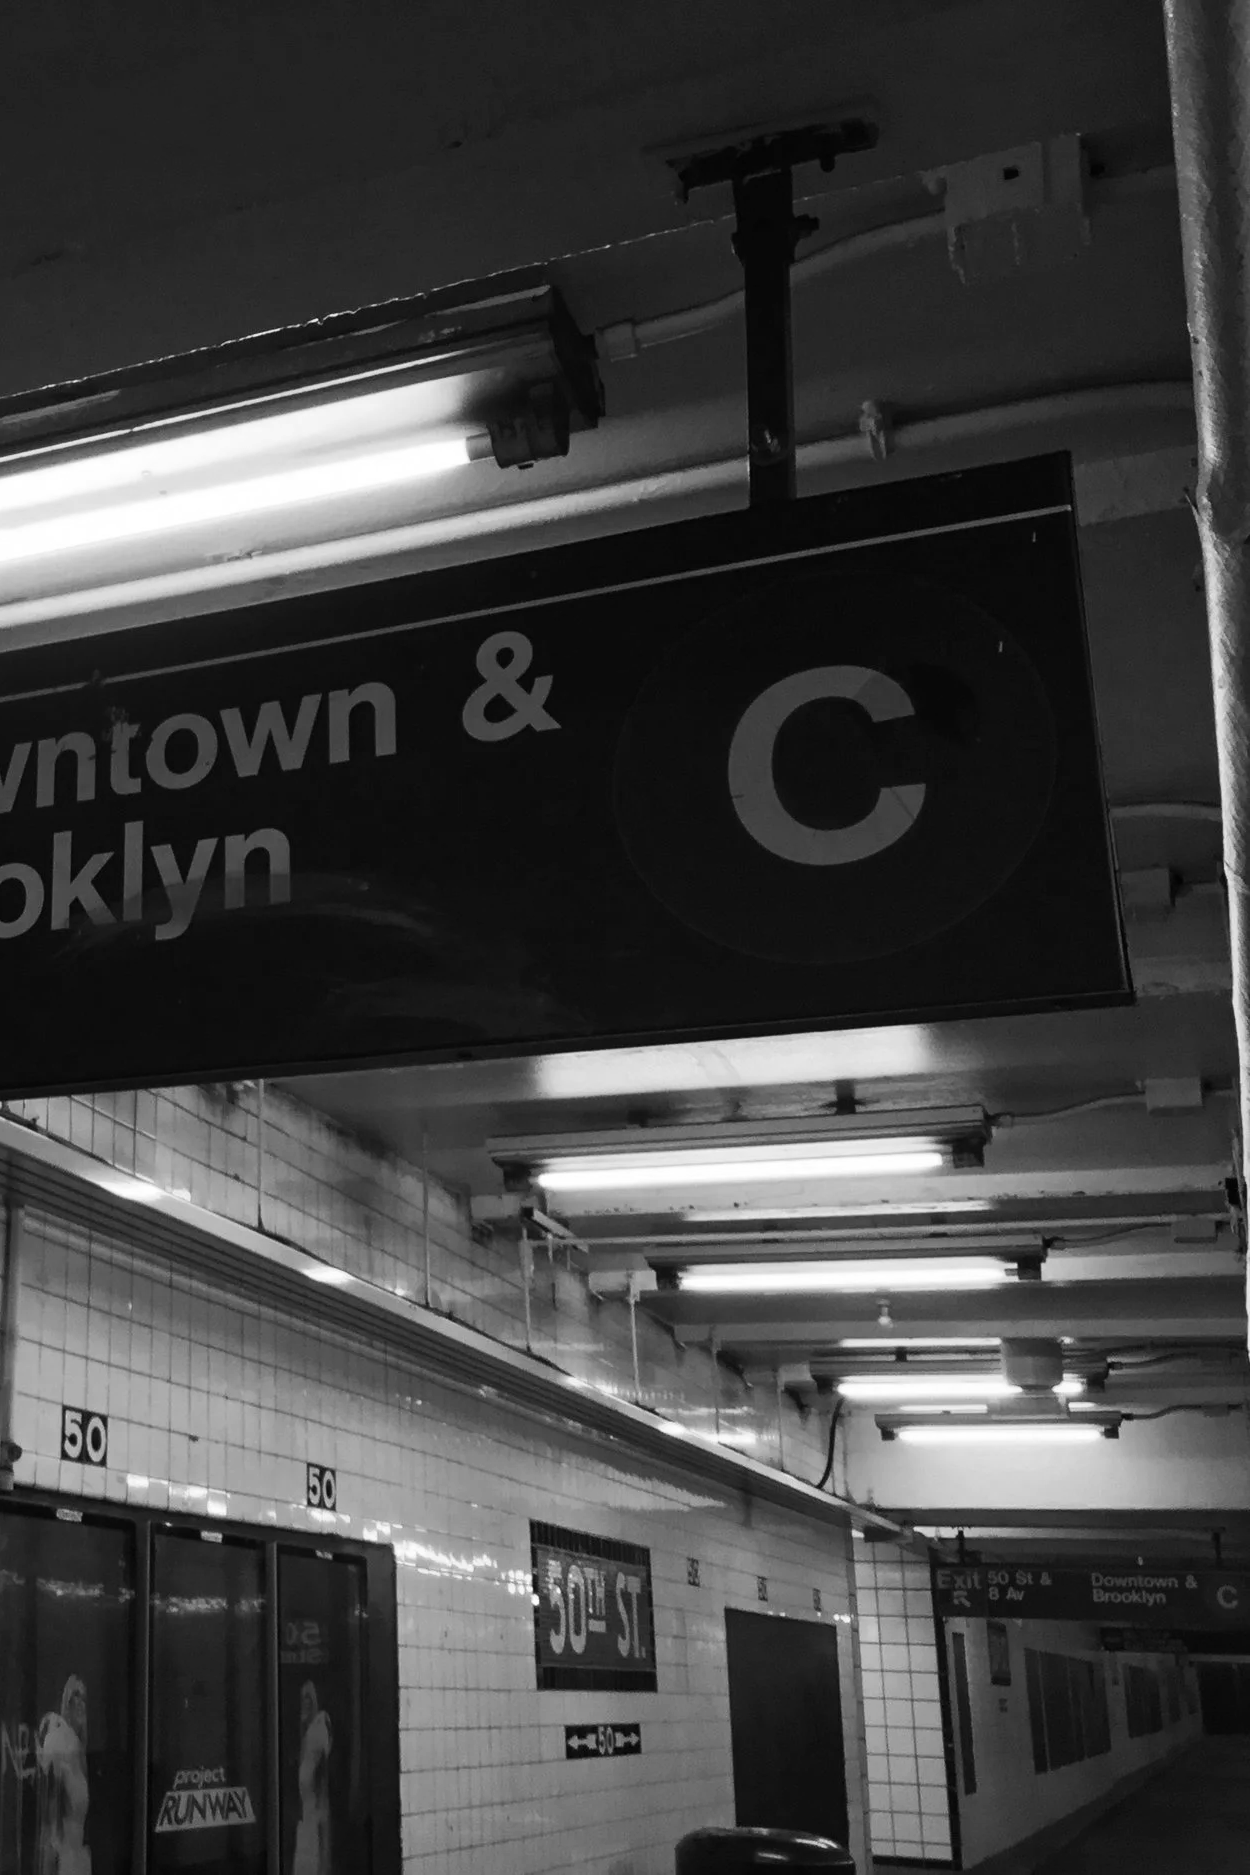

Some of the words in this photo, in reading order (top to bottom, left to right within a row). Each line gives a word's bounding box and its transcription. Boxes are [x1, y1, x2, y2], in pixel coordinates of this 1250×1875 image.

[462, 630, 562, 742] &
[727, 664, 927, 867] C
[64, 1411, 108, 1464] 50
[307, 1467, 336, 1508] 50
[936, 1570, 983, 1590] Exit
[987, 1570, 1010, 1585] 50
[1015, 1569, 1035, 1586] St
[1040, 1571, 1053, 1586] &
[1091, 1571, 1179, 1588] Downtown
[1185, 1574, 1199, 1589] &
[988, 1587, 1000, 1601] 8
[1006, 1586, 1026, 1601] Av
[1092, 1588, 1167, 1607] Brooklyn
[1216, 1584, 1239, 1610] C
[598, 1726, 615, 1756] 50
[173, 1766, 227, 1790] project
[160, 1789, 248, 1827] RUNWAY
